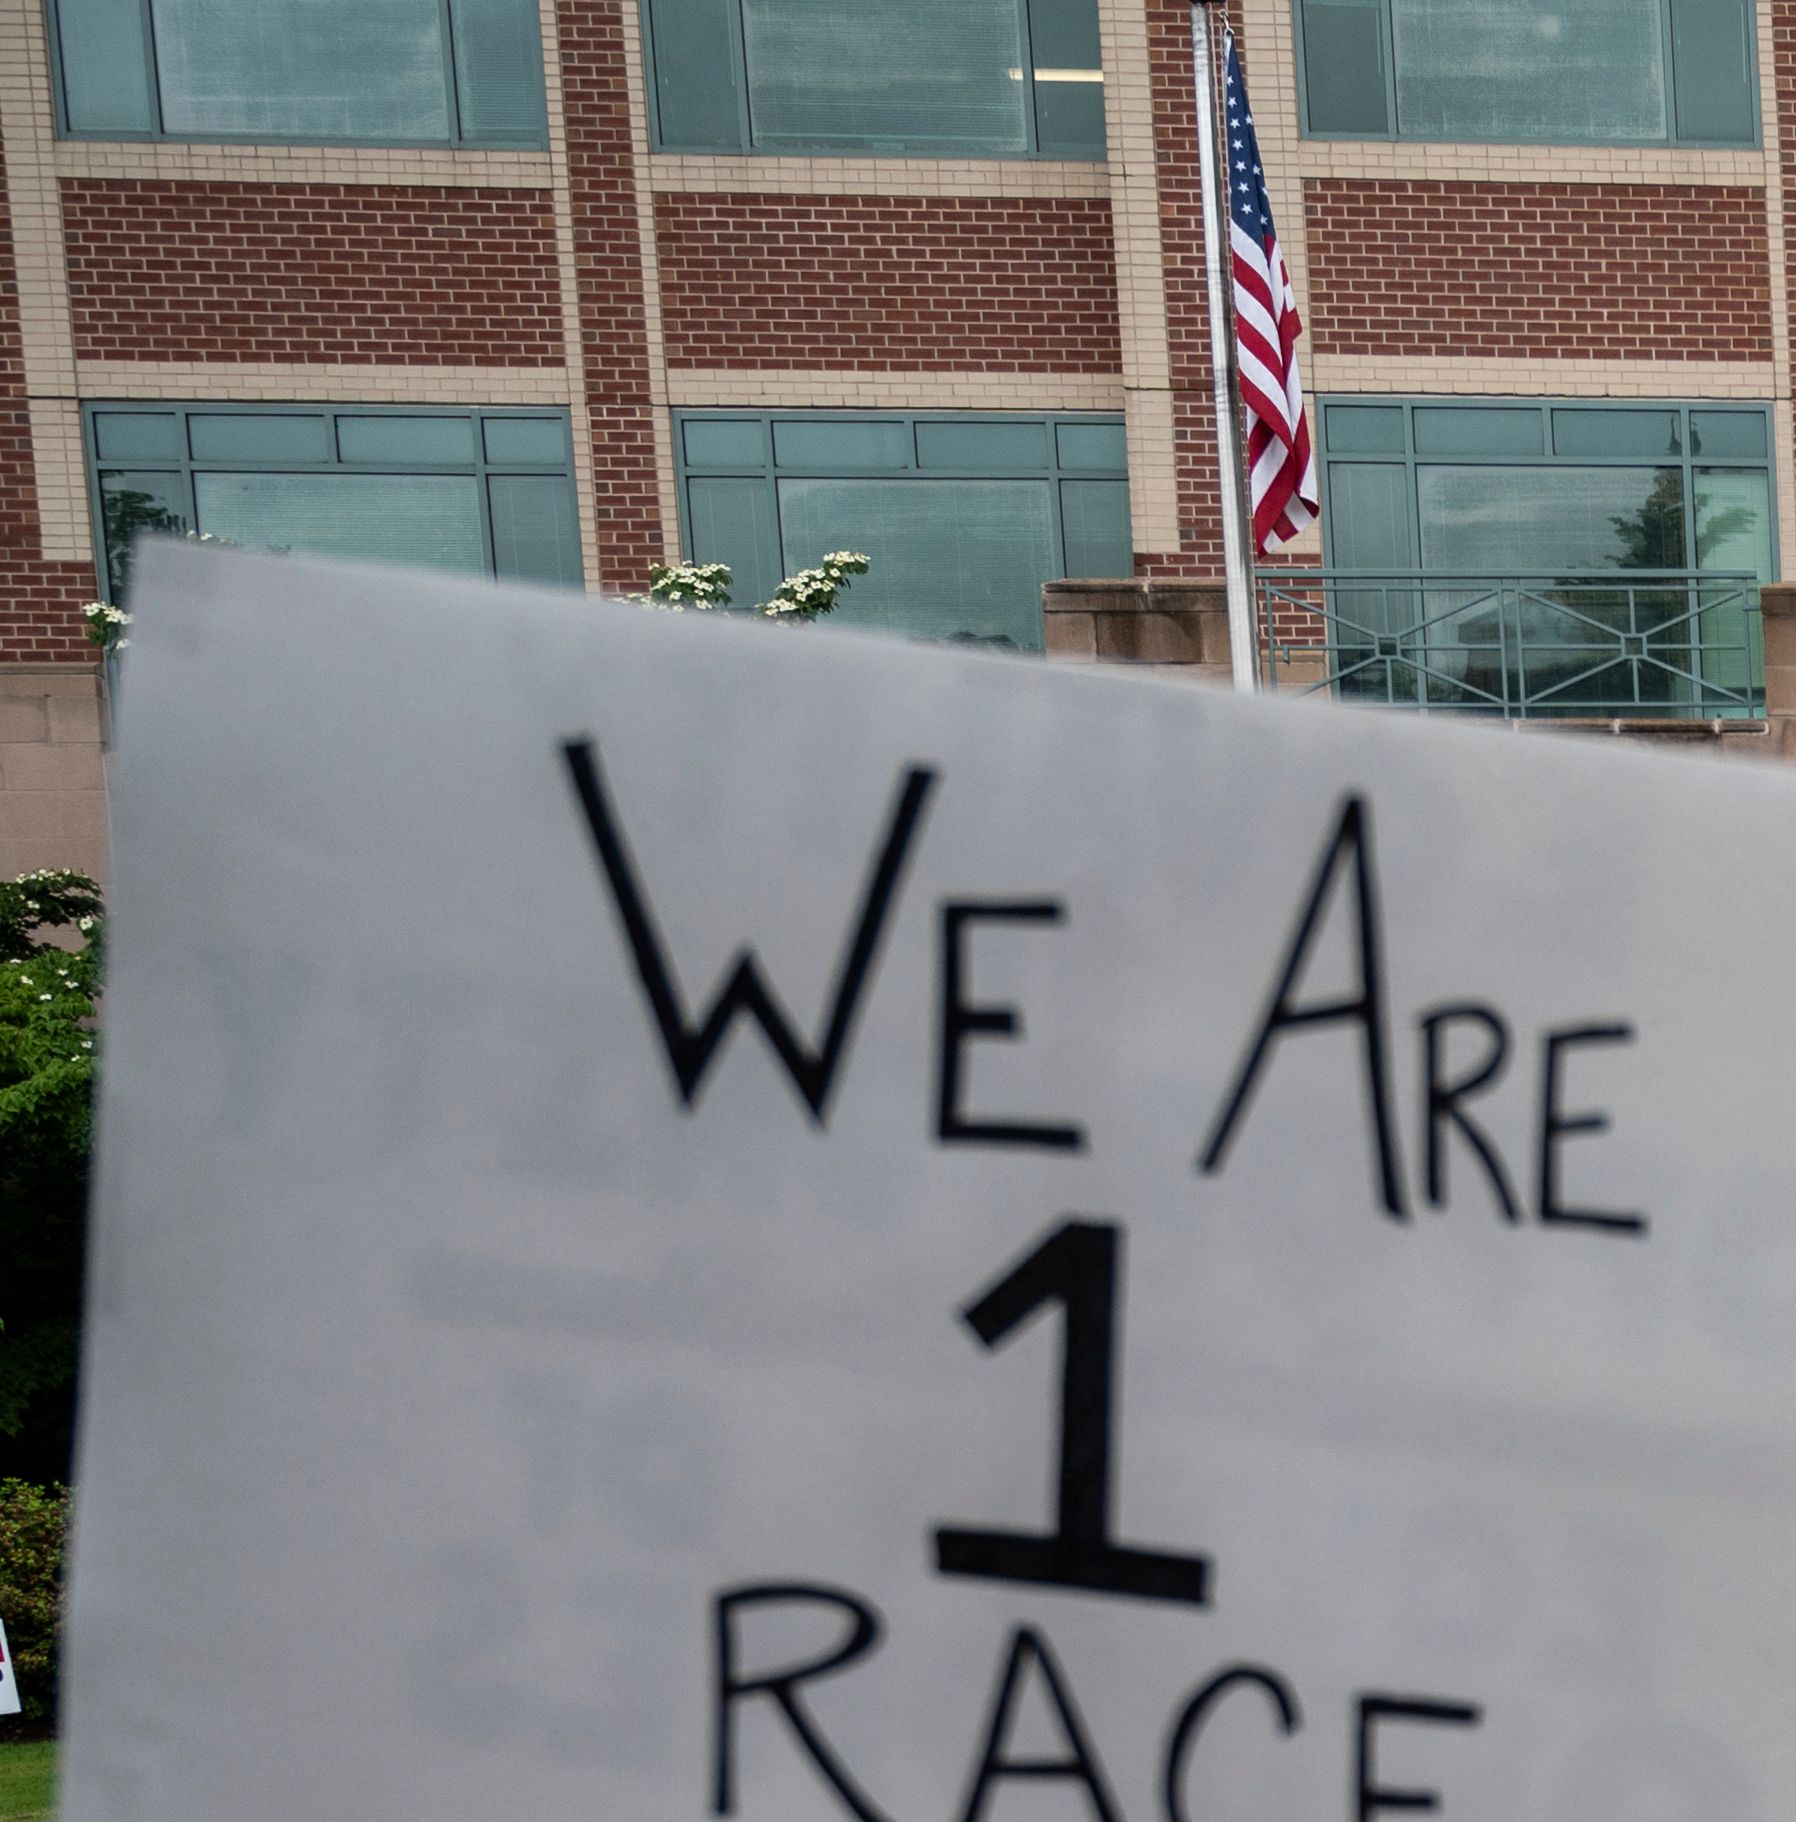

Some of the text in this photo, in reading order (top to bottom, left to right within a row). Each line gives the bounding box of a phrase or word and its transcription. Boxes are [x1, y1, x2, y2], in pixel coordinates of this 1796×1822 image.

[557, 731, 1649, 1239] WE ARE
[928, 1210, 1214, 1612] 1
